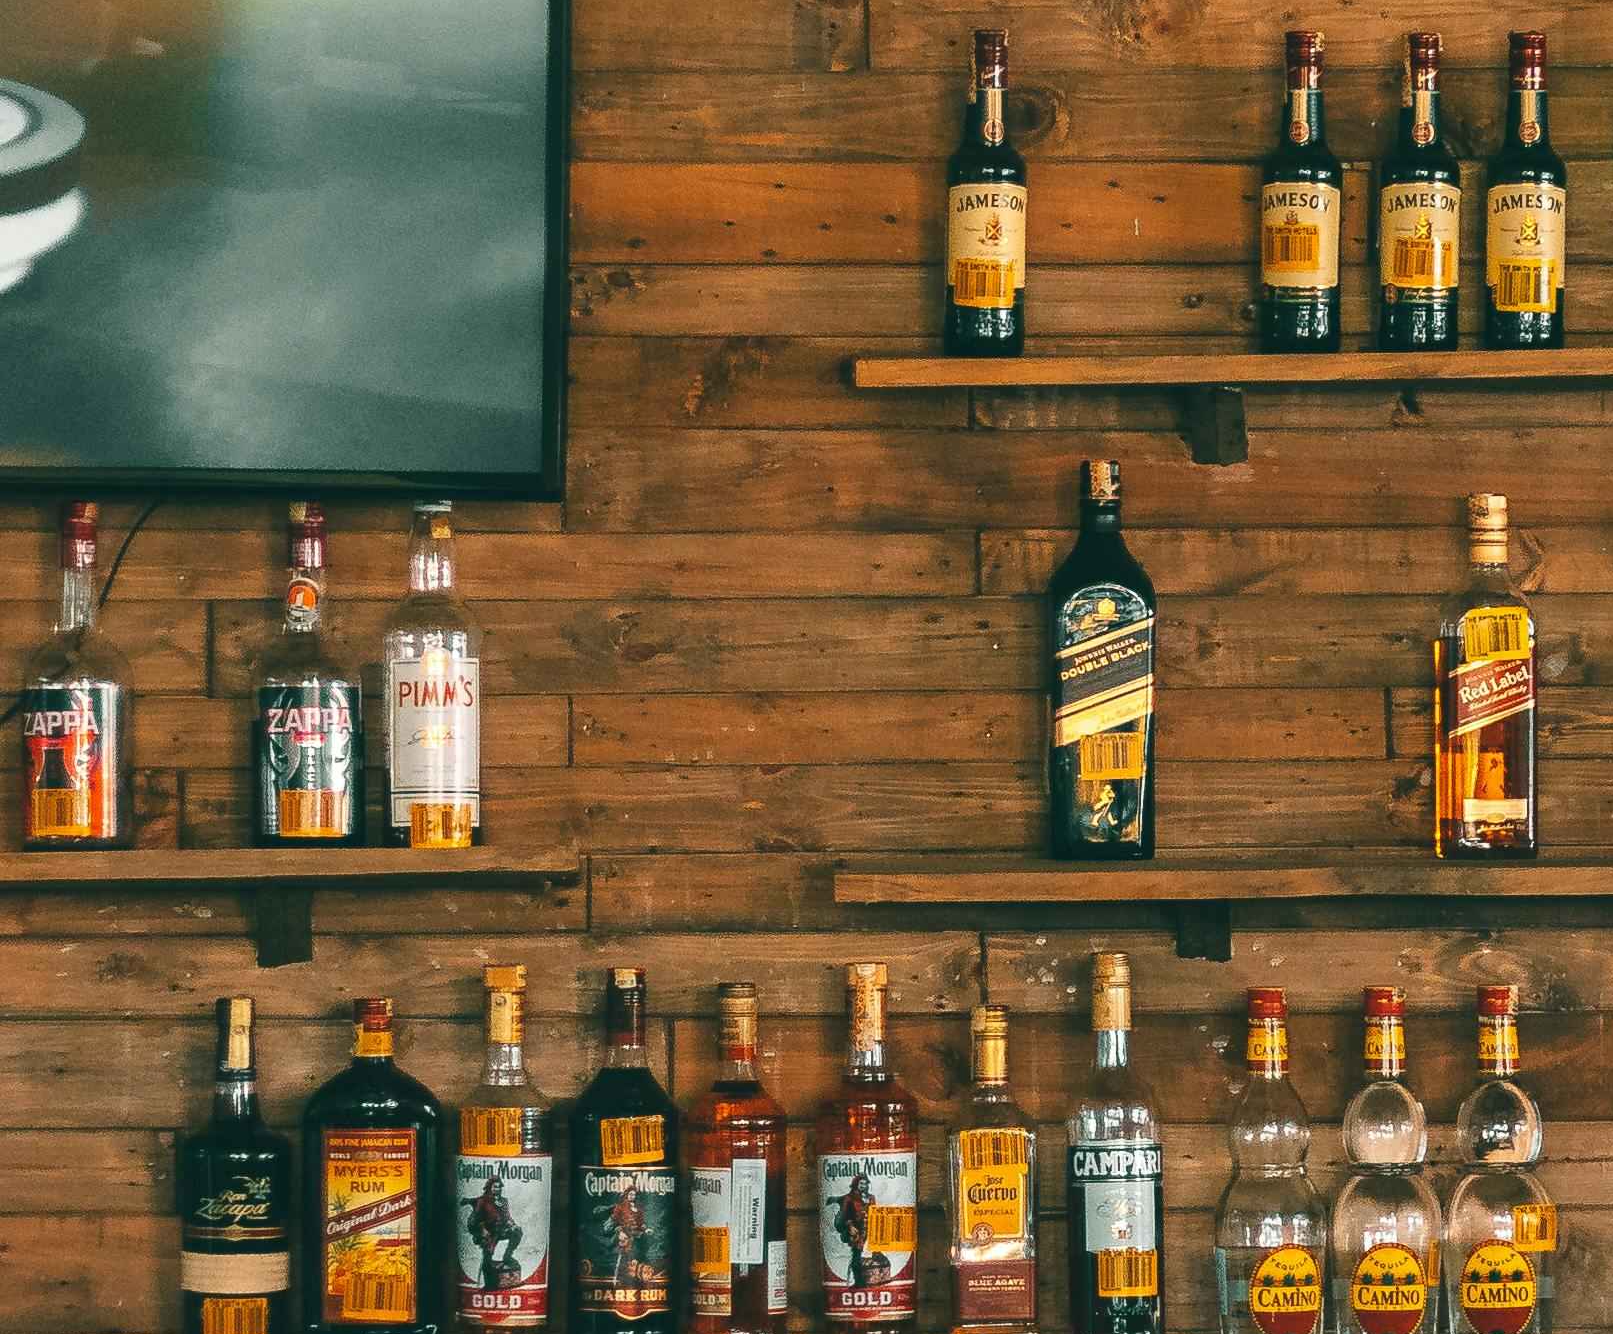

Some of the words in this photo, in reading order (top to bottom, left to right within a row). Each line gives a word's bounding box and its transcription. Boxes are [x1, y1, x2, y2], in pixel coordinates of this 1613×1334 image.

[956, 194, 1025, 213] JAMESON
[1061, 658, 1109, 681] DOUBLE
[1110, 641, 1151, 662] BLACK
[400, 675, 474, 707] PIMM'S
[1459, 680, 1490, 704] Red
[1490, 666, 1530, 692] Label
[24, 710, 99, 735] ZAPPA
[266, 708, 352, 733] ZAPPA
[334, 1165, 404, 1177] MYERS'S
[499, 1161, 542, 1184] Morgan
[824, 1158, 860, 1180] Captain
[863, 1157, 908, 1180] Morgan
[1073, 1150, 1161, 1177] CAMPARI
[350, 1181, 385, 1193] RUM
[586, 1172, 635, 1196] Captain
[968, 1183, 1018, 1204] Cuervo
[196, 1198, 270, 1223] Zacapa
[326, 1210, 377, 1235] Original
[377, 1195, 412, 1216] Dark
[750, 1197, 761, 1240] Warning
[1271, 1255, 1310, 1271] TEQUILA
[1369, 1255, 1410, 1270] TEQUILA
[1476, 1253, 1516, 1269] TEQUILA
[968, 1278, 993, 1287] BLUE
[996, 1278, 1026, 1287] AGAVE
[472, 1294, 522, 1309] GOLD
[594, 1288, 636, 1302] DARK
[640, 1288, 667, 1302] RUM
[842, 1292, 892, 1306] GOLD
[1258, 1287, 1317, 1308] CAMINO
[1358, 1287, 1420, 1307] CAMINO
[1467, 1283, 1529, 1304] CAMINO
